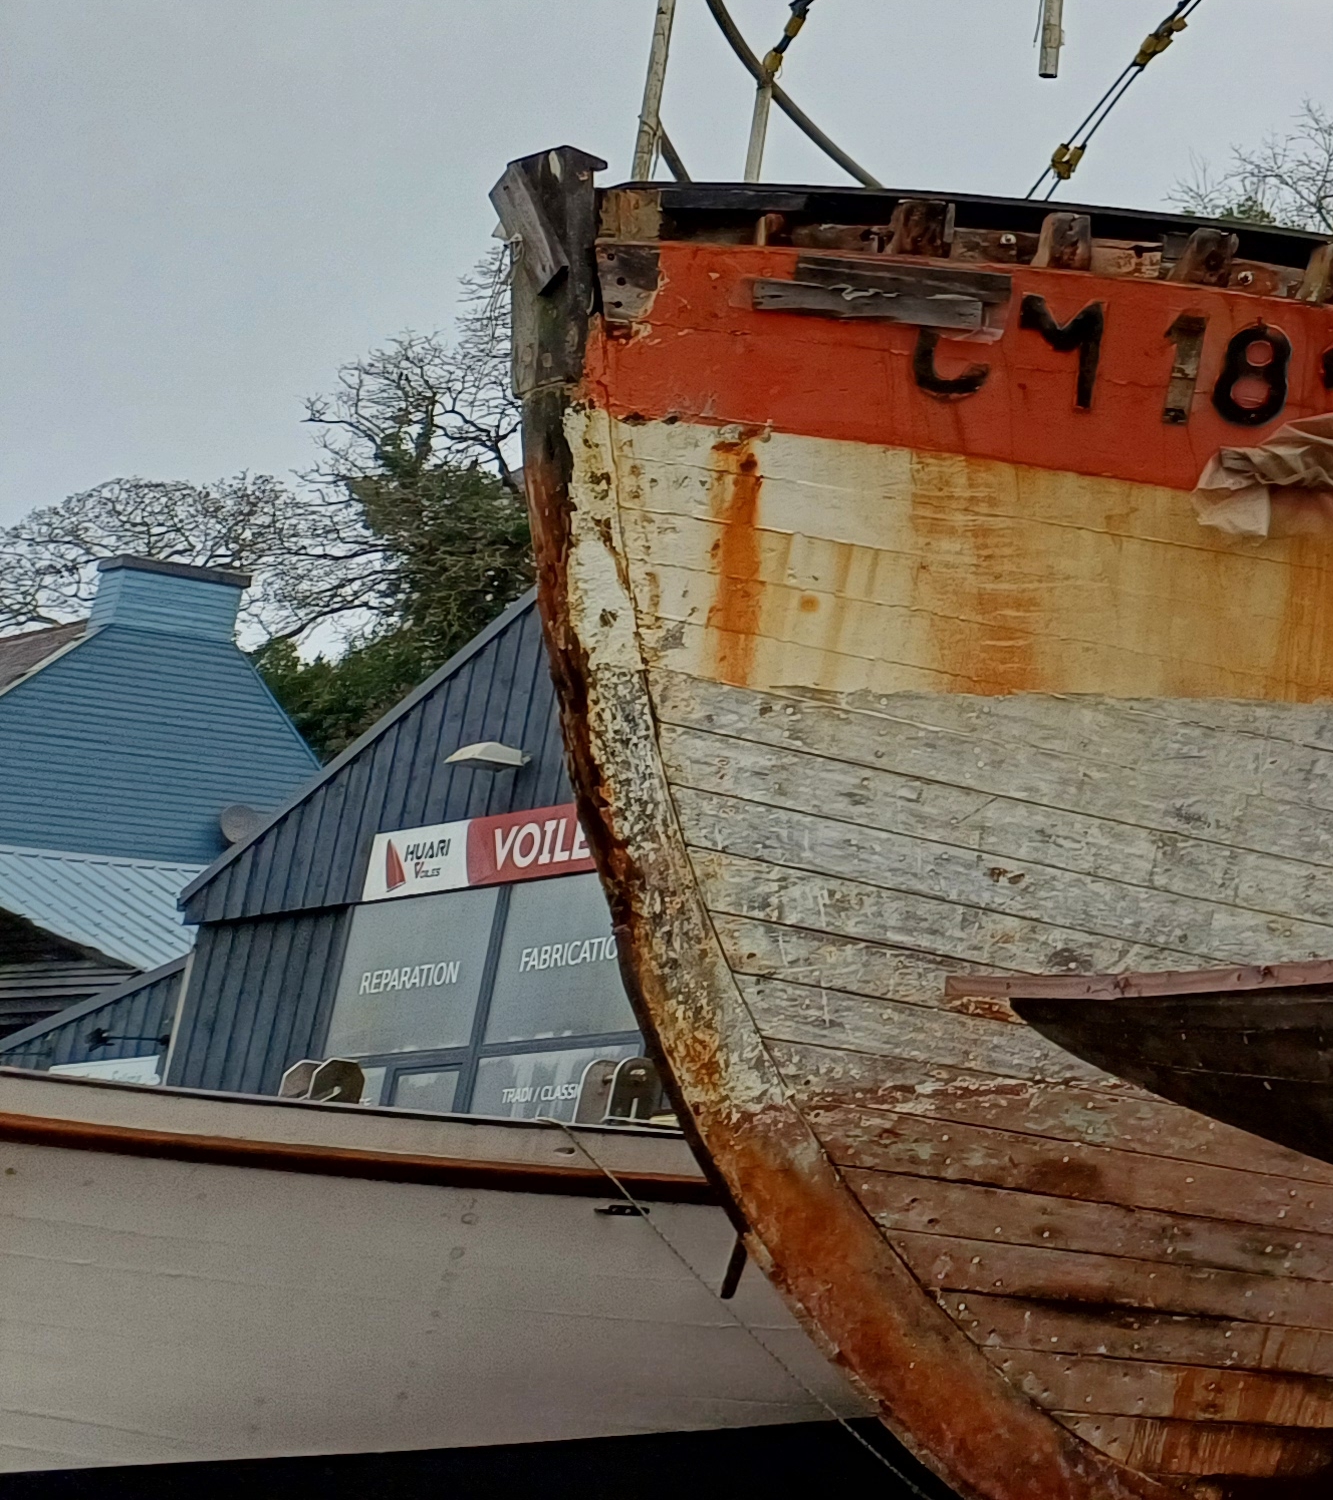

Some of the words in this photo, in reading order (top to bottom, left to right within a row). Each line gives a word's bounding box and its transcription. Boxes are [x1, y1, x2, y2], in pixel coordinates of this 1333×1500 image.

[404, 838, 451, 862] HUARI
[359, 961, 460, 995] REPARATION
[502, 1088, 532, 1104] TRADI
